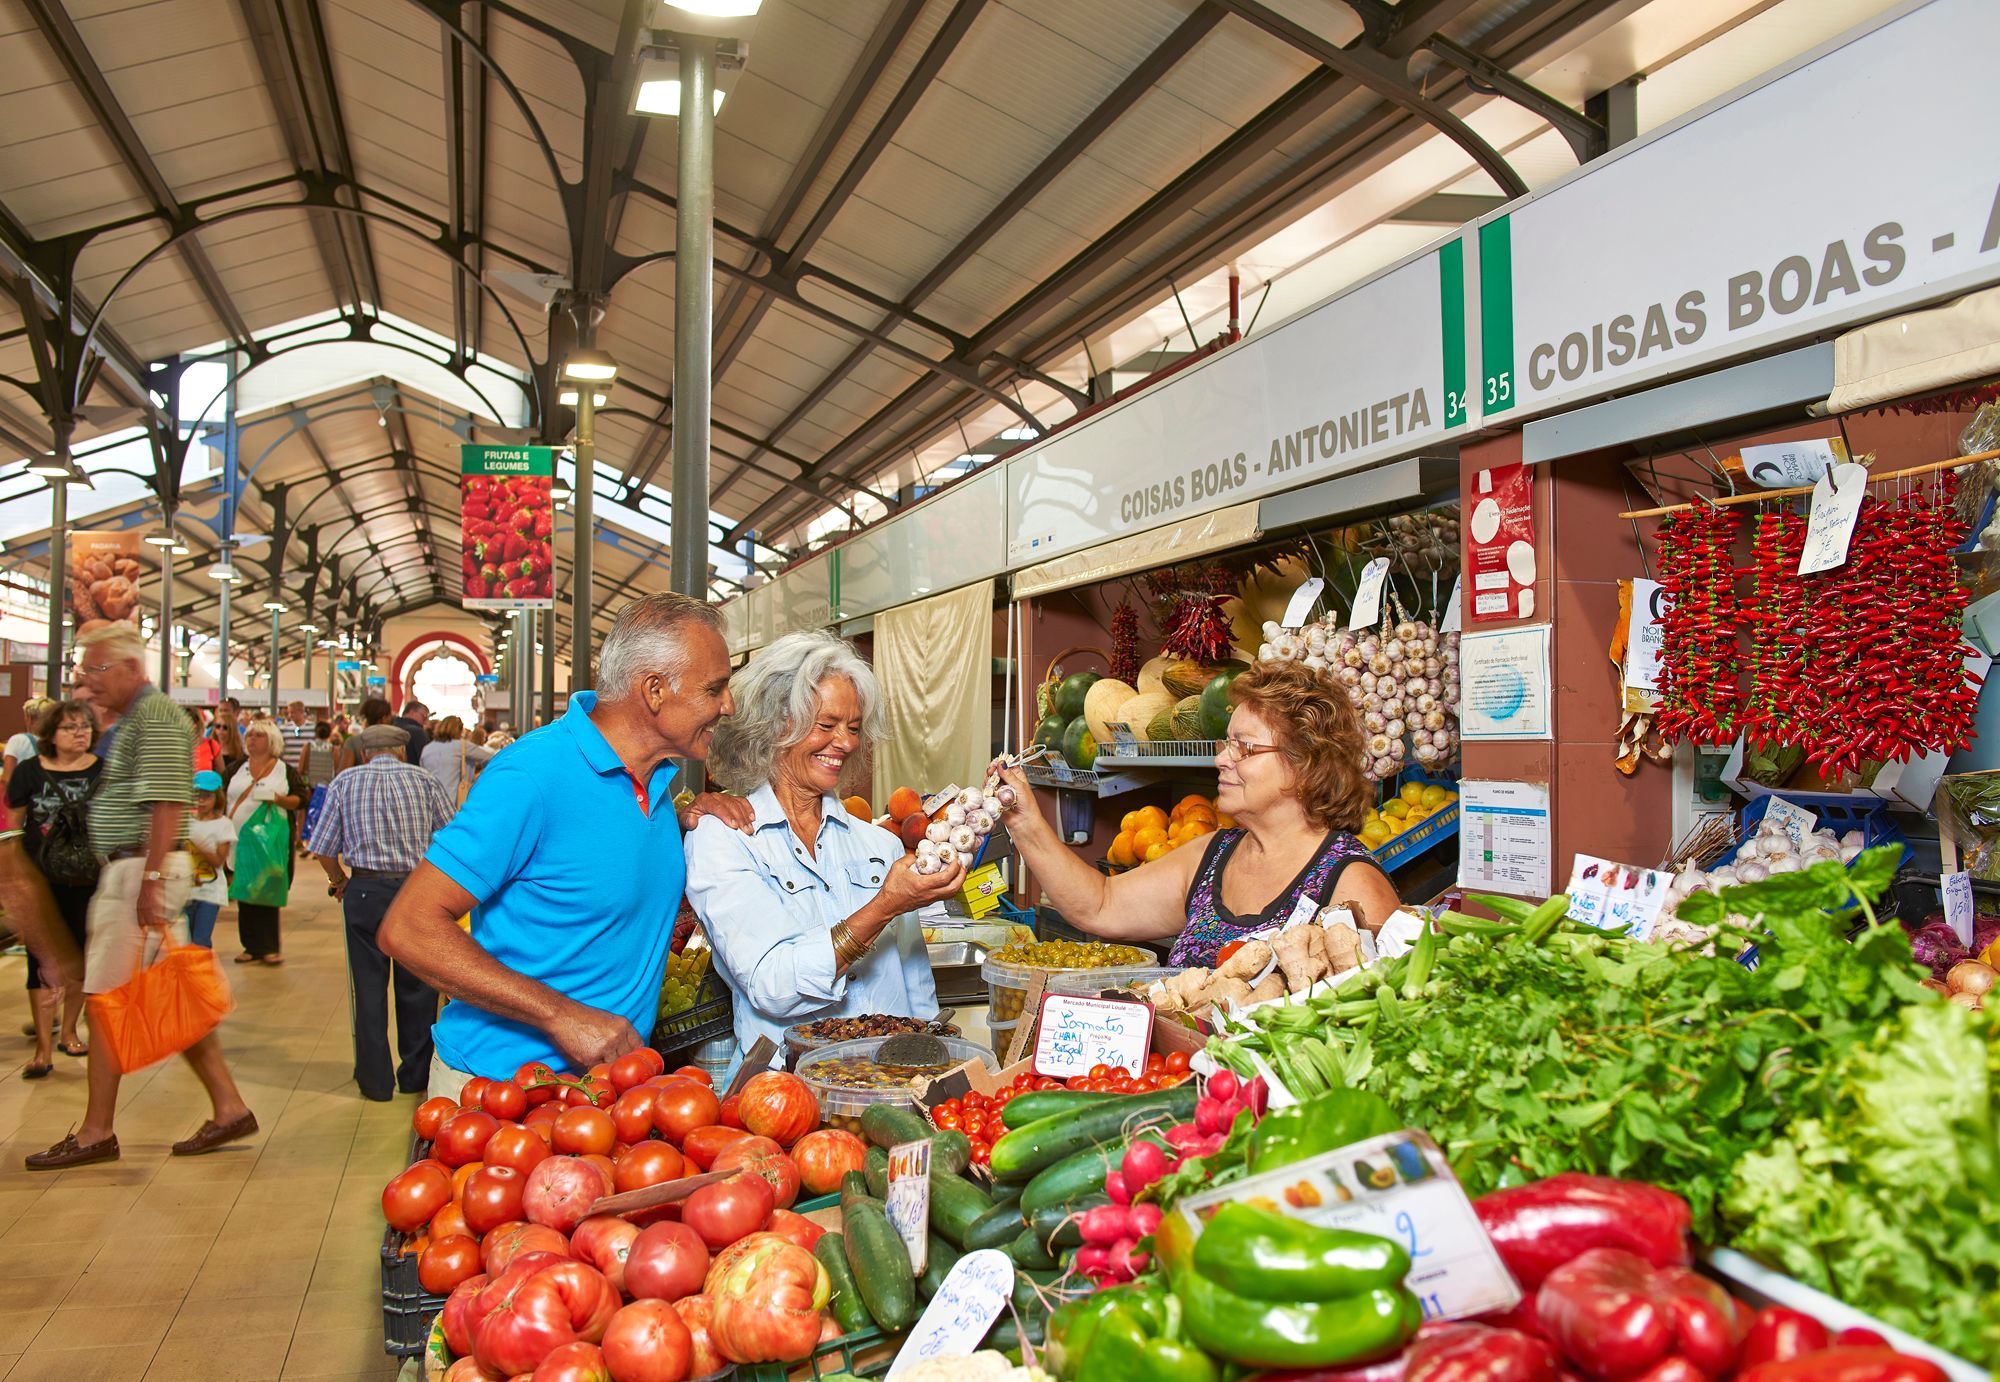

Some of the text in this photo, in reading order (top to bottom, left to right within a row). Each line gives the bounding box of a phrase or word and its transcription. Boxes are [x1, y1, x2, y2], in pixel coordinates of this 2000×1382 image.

[1528, 222, 1954, 391] COISAS BOAS -
[1487, 372, 1510, 405] 35
[484, 451, 529, 460] FRUTAS E
[1121, 387, 1431, 523] COISAS BOAS - ANTONIETA
[484, 462, 529, 471] LEGUMES
[1063, 999, 1085, 1007] Mercado
[1086, 1002, 1111, 1010] Municipal
[1131, 1059, 1138, 1069] €
[1396, 1212, 1433, 1258] 2
